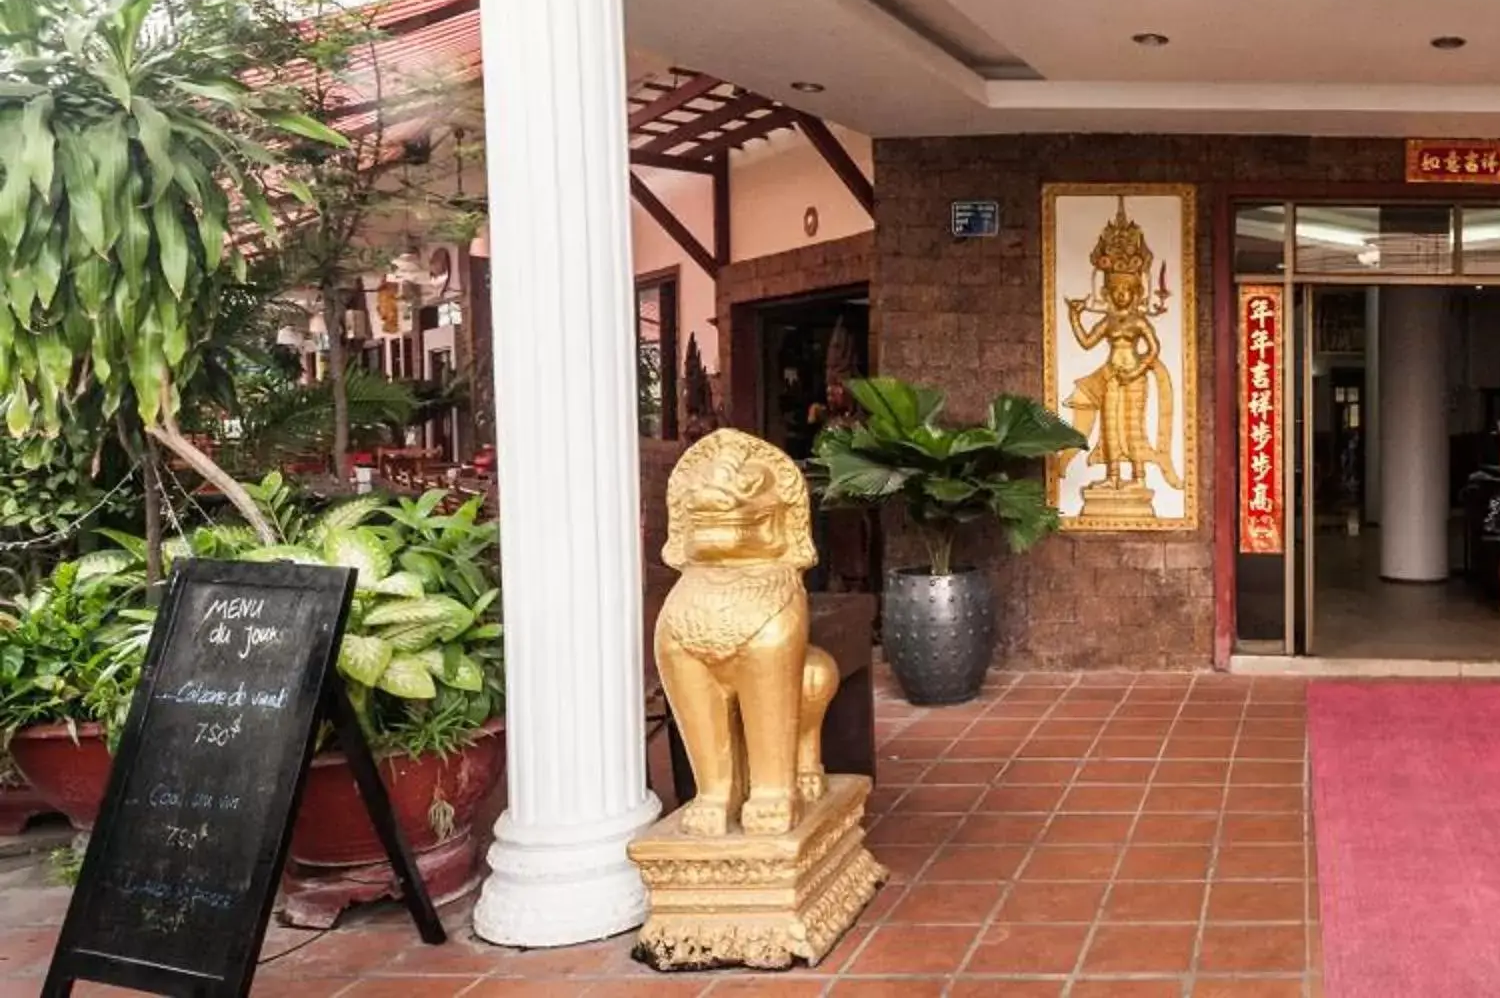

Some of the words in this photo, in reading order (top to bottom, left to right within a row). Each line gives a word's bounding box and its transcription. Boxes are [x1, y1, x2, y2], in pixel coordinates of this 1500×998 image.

[1248, 299, 1274, 513] 年年吉祥步步高
